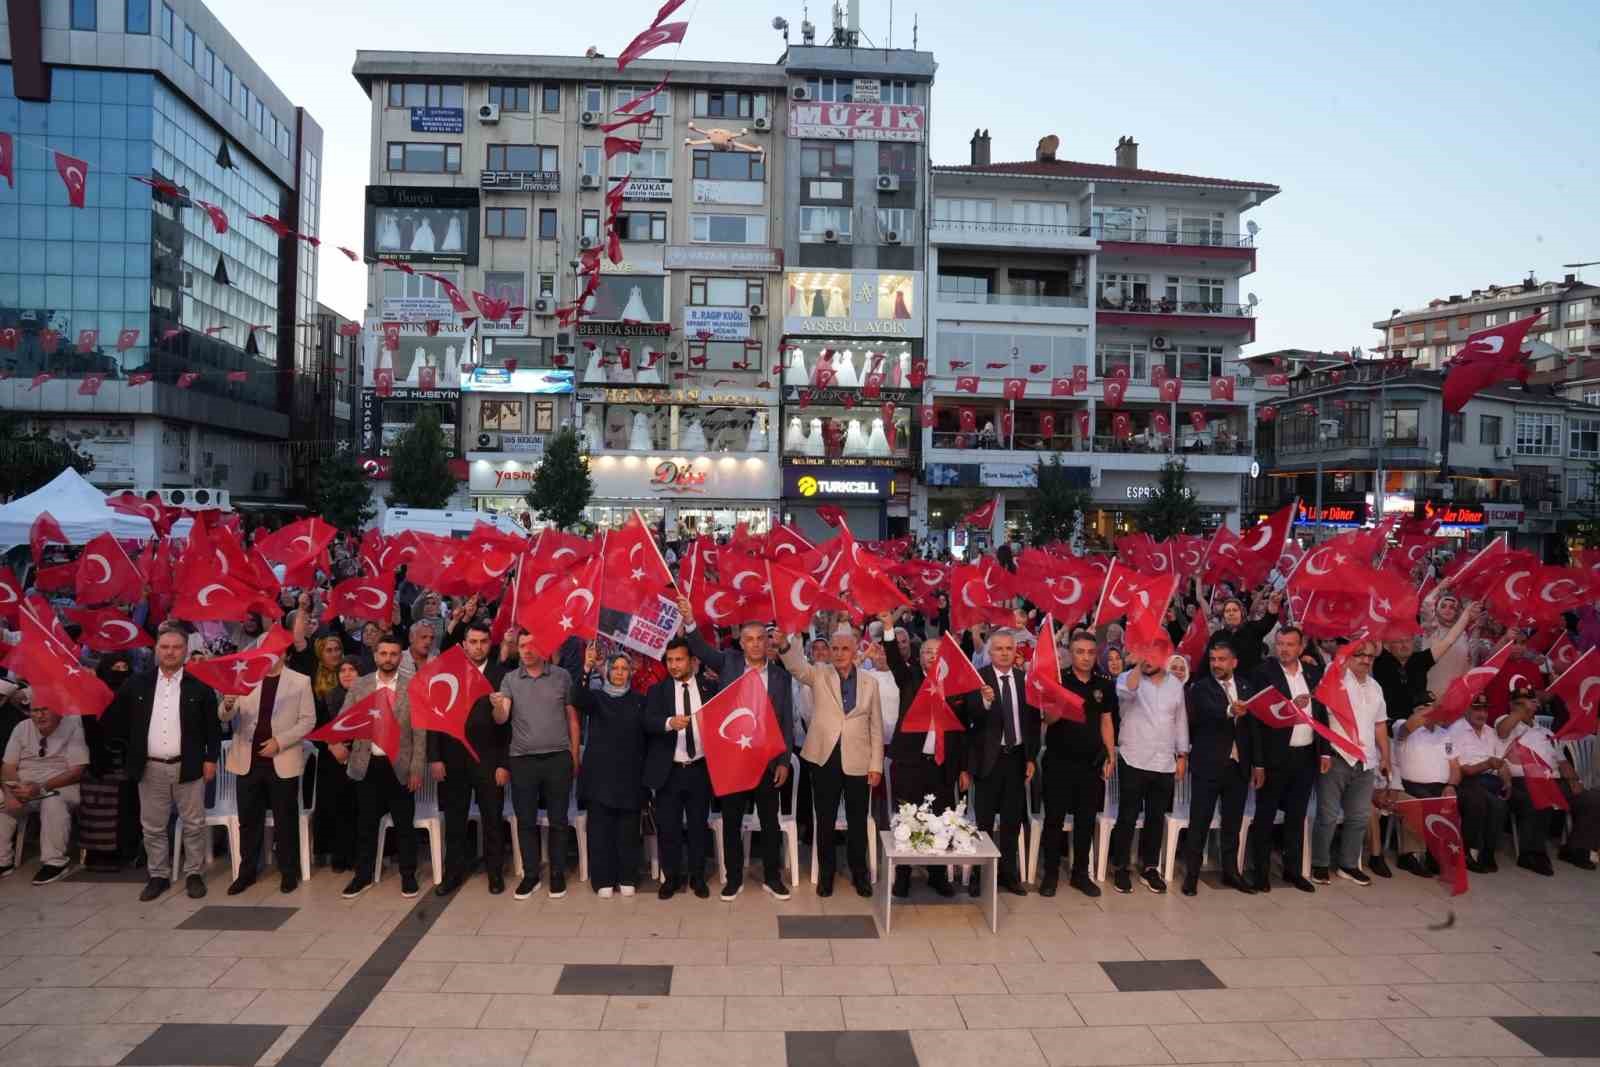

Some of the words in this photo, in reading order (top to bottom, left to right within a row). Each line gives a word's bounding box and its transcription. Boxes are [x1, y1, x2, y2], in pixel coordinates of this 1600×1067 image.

[1308, 506, 1329, 519] Lier
[1329, 506, 1355, 520] Döner
[1458, 508, 1483, 522] Döner
